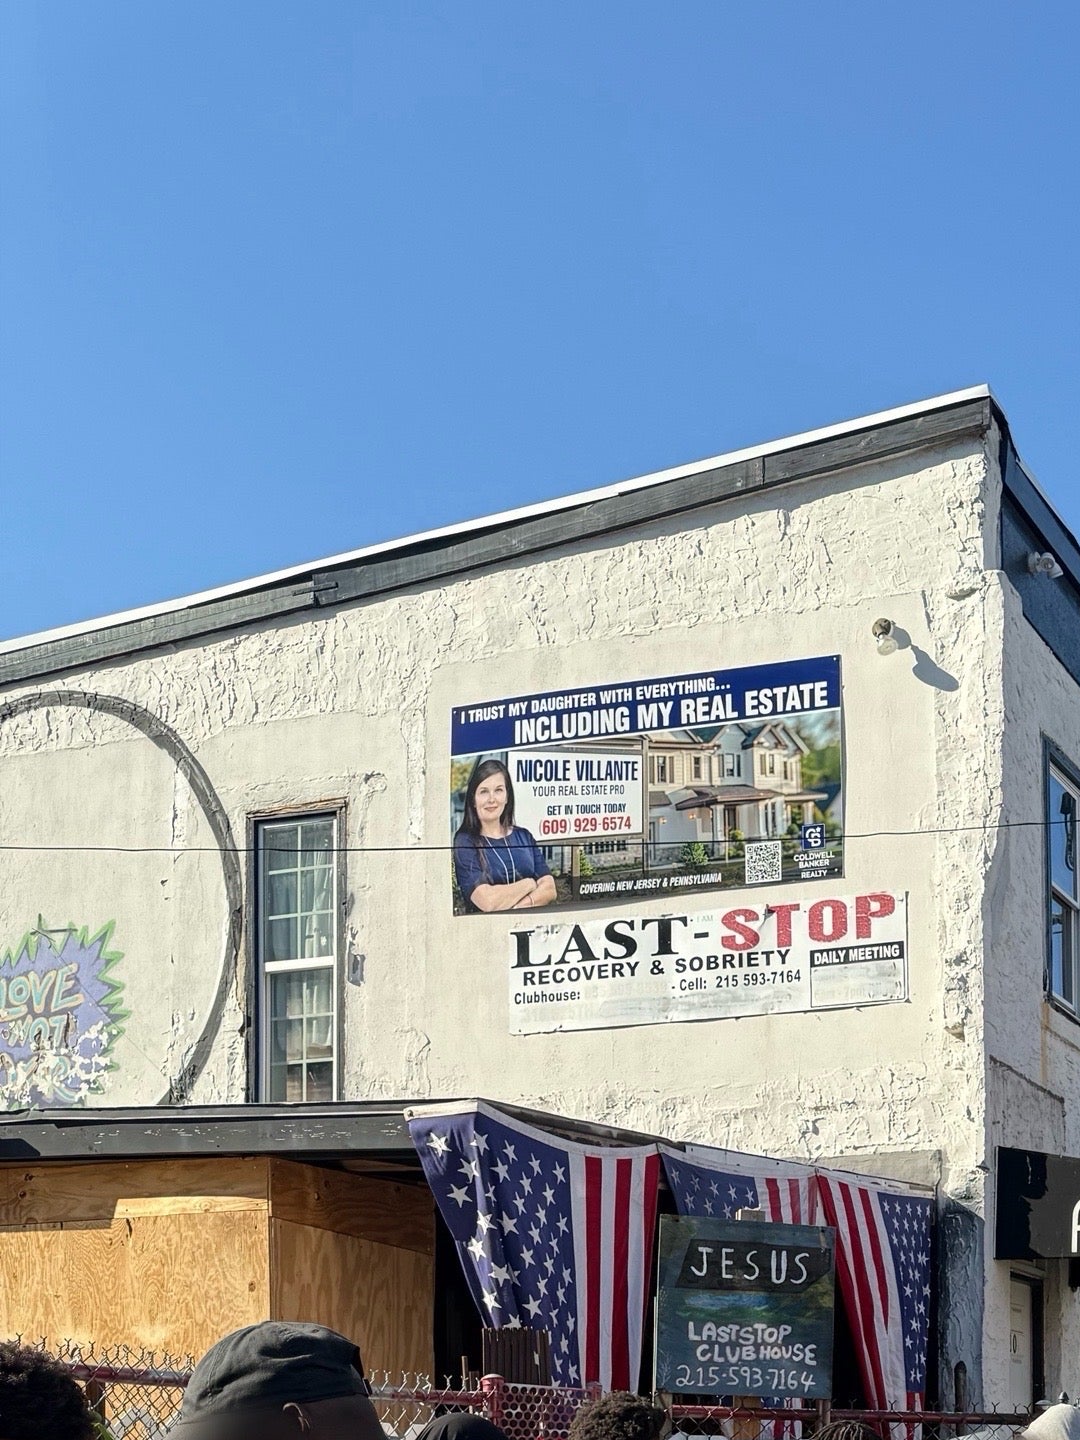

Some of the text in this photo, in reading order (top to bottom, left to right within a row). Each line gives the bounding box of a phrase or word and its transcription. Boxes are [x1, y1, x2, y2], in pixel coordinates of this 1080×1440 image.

[461, 677, 730, 724] I TRUST MY DAUGHTER WITH EVERYTHING...
[514, 681, 828, 745] INCLUDING MY REAL ESTATE
[516, 759, 638, 782] NICOLE VILLANTE
[533, 784, 625, 797] YOUR REAL ESTATE PRO
[547, 803, 627, 816] GET IN TOUCH TODAY
[539, 816, 631, 836] (609) 929-6574
[793, 850, 835, 862] COLDWELL
[798, 858, 830, 869] BANKER
[579, 872, 722, 895] COVERING NEW JERSEY & PENNSYLVANIA
[801, 869, 828, 879] REALTY
[814, 944, 899, 965] DAILY MEETING
[523, 949, 791, 986] RECOVERY & SOBRIETY
[514, 990, 580, 1005] Clubhouse:
[680, 976, 707, 991] Cell:
[716, 974, 739, 989] 215
[743, 969, 801, 987] 593-7164
[690, 1246, 810, 1285] JESUS
[676, 1364, 816, 1393] 215-593-7164
